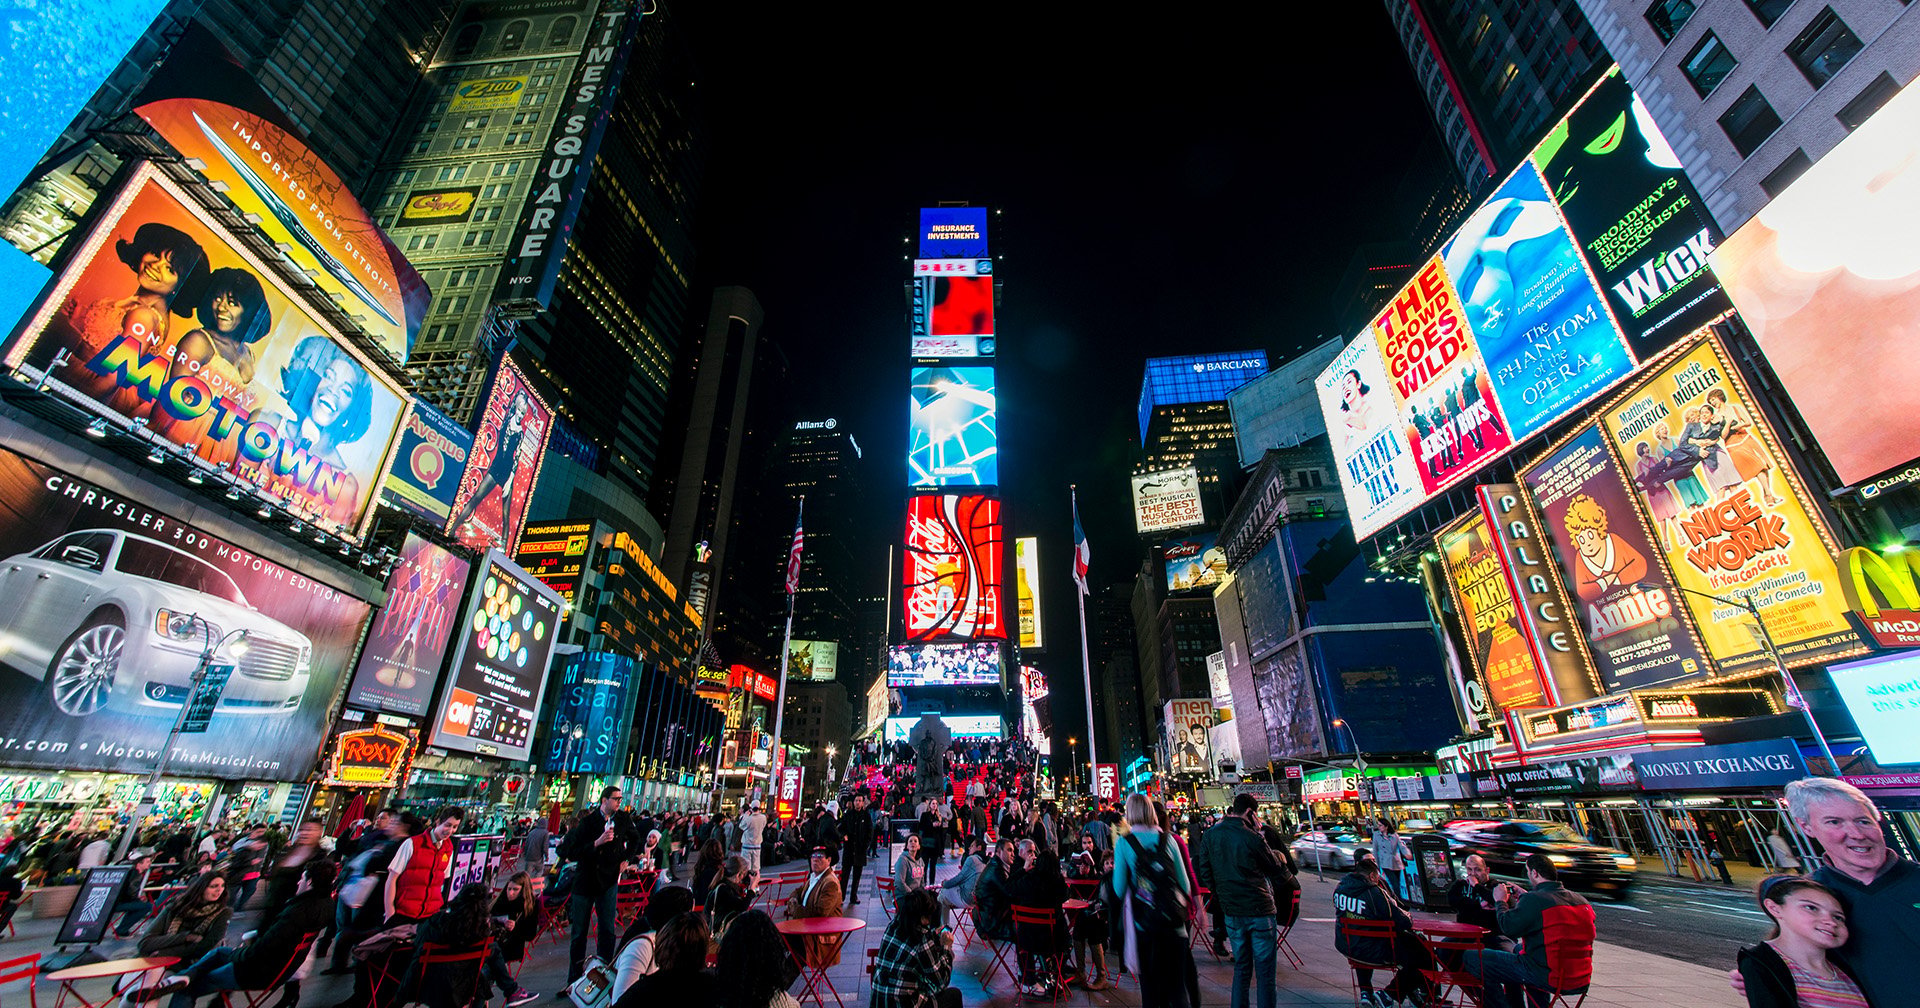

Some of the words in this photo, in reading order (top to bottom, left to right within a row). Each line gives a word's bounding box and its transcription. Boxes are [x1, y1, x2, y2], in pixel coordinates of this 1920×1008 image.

[577, 12, 626, 102] TIMES
[464, 80, 520, 98] Z100
[232, 121, 307, 203] IMPORTED
[309, 203, 343, 243] FROM
[519, 114, 586, 258] SQUARE
[928, 232, 980, 240] INVESTMENTS
[1598, 210, 1651, 260] BIGGEST
[509, 276, 532, 285] NYC
[1517, 262, 1579, 316] Longest-Running
[1523, 260, 1564, 298] Broadway's
[1672, 276, 1694, 294] STORY
[1376, 262, 1445, 341] THE
[1536, 287, 1565, 313] Musical
[132, 322, 160, 346] ON
[1385, 291, 1450, 358] CROWD
[1522, 320, 1550, 344] The
[1390, 308, 1458, 378] GOES
[1497, 304, 1599, 387] PHANTOM
[166, 346, 255, 407] BROADWAY
[1206, 359, 1262, 372] BARCLAYS
[1522, 352, 1596, 406] OPERA
[1533, 363, 1547, 379] of
[1550, 348, 1568, 367] the
[1672, 360, 1703, 390] Jessie
[1672, 368, 1721, 408] MUELLER
[85, 334, 350, 505] MOTOWN
[795, 420, 824, 430] Allianz
[1617, 402, 1670, 445] BRODERICK
[1618, 395, 1654, 425] Matthew
[406, 412, 467, 463] Avenue
[456, 365, 518, 522] CHICAGO
[1420, 424, 1457, 464] JERSEY
[1456, 399, 1492, 437] BOYS
[238, 461, 270, 488] THE
[410, 441, 445, 491] Q
[1346, 430, 1402, 489] MAMMA
[1533, 465, 1570, 496] FEEL-GOOD
[1569, 445, 1602, 472] MUSICAL
[1552, 445, 1587, 476] ULTIMATE
[1540, 490, 1564, 510] BETTER
[1563, 478, 1583, 499] THAN
[1546, 485, 1557, 496] IS
[1556, 472, 1575, 491] BACK
[1574, 461, 1591, 478] AND
[271, 481, 333, 519] MUSICAL
[1139, 499, 1159, 507] BEST
[1160, 493, 1196, 503] MUSICAL
[1141, 509, 1183, 521] MUSICAL
[1184, 506, 1198, 515] OF
[1166, 499, 1196, 511] BEST
[527, 525, 560, 535] THOMSON
[560, 523, 591, 534] REUTERS
[1142, 518, 1160, 528] THIS
[1679, 488, 1764, 547] NICE
[45, 476, 165, 533] CHRYSLER
[173, 527, 209, 551] 300
[216, 544, 286, 581] MOTOWN
[290, 575, 344, 604] EDITION
[1686, 515, 1792, 575] WORK
[1456, 552, 1502, 591] HANDS
[1500, 494, 1571, 653] PALACE
[1710, 574, 1719, 589] If
[1719, 570, 1741, 587] You
[1740, 566, 1758, 583] Can
[1757, 558, 1777, 573] Get
[1777, 554, 1789, 567] It
[1733, 570, 1807, 601] Tony-Winning
[1468, 571, 1512, 616] HARD
[1596, 597, 1607, 606] THE
[1606, 588, 1629, 602] MUSICAL
[1711, 607, 1734, 623] New
[1734, 596, 1775, 615] Msical
[1774, 581, 1823, 605] Comedy
[1788, 600, 1818, 614] GERSHWIN
[378, 587, 451, 656] PIPPIN
[1474, 601, 1517, 634] BODY
[1589, 583, 1673, 642] Annie
[1779, 626, 1805, 639] KATHLEEN
[1805, 620, 1834, 634] MARSHALL
[1608, 634, 1671, 658] TICKETMASTER.COM
[1612, 657, 1622, 665] OR
[1620, 642, 1673, 663] 877-250-2929
[1615, 654, 1681, 677] ANNIETHEMUSICAL.COM
[583, 677, 604, 686] Morgan
[604, 678, 622, 688] Stanley
[447, 701, 474, 726] CNN
[1172, 699, 1213, 716] men
[1174, 716, 1184, 725] at
[1651, 699, 1699, 718] Annie
[1872, 698, 1908, 713] this
[96, 740, 281, 770] MotowTheMusical.com
[345, 736, 398, 765] ROXY
[1505, 771, 1523, 783] BOX
[1522, 769, 1550, 781] OFFICE
[1550, 766, 1574, 779] HERE
[1640, 760, 1692, 779] MONEY
[1696, 754, 1795, 775] EXCHANGE
[113, 783, 178, 802] SLM
[784, 769, 799, 801] tkts
[1098, 766, 1113, 799] tkts
